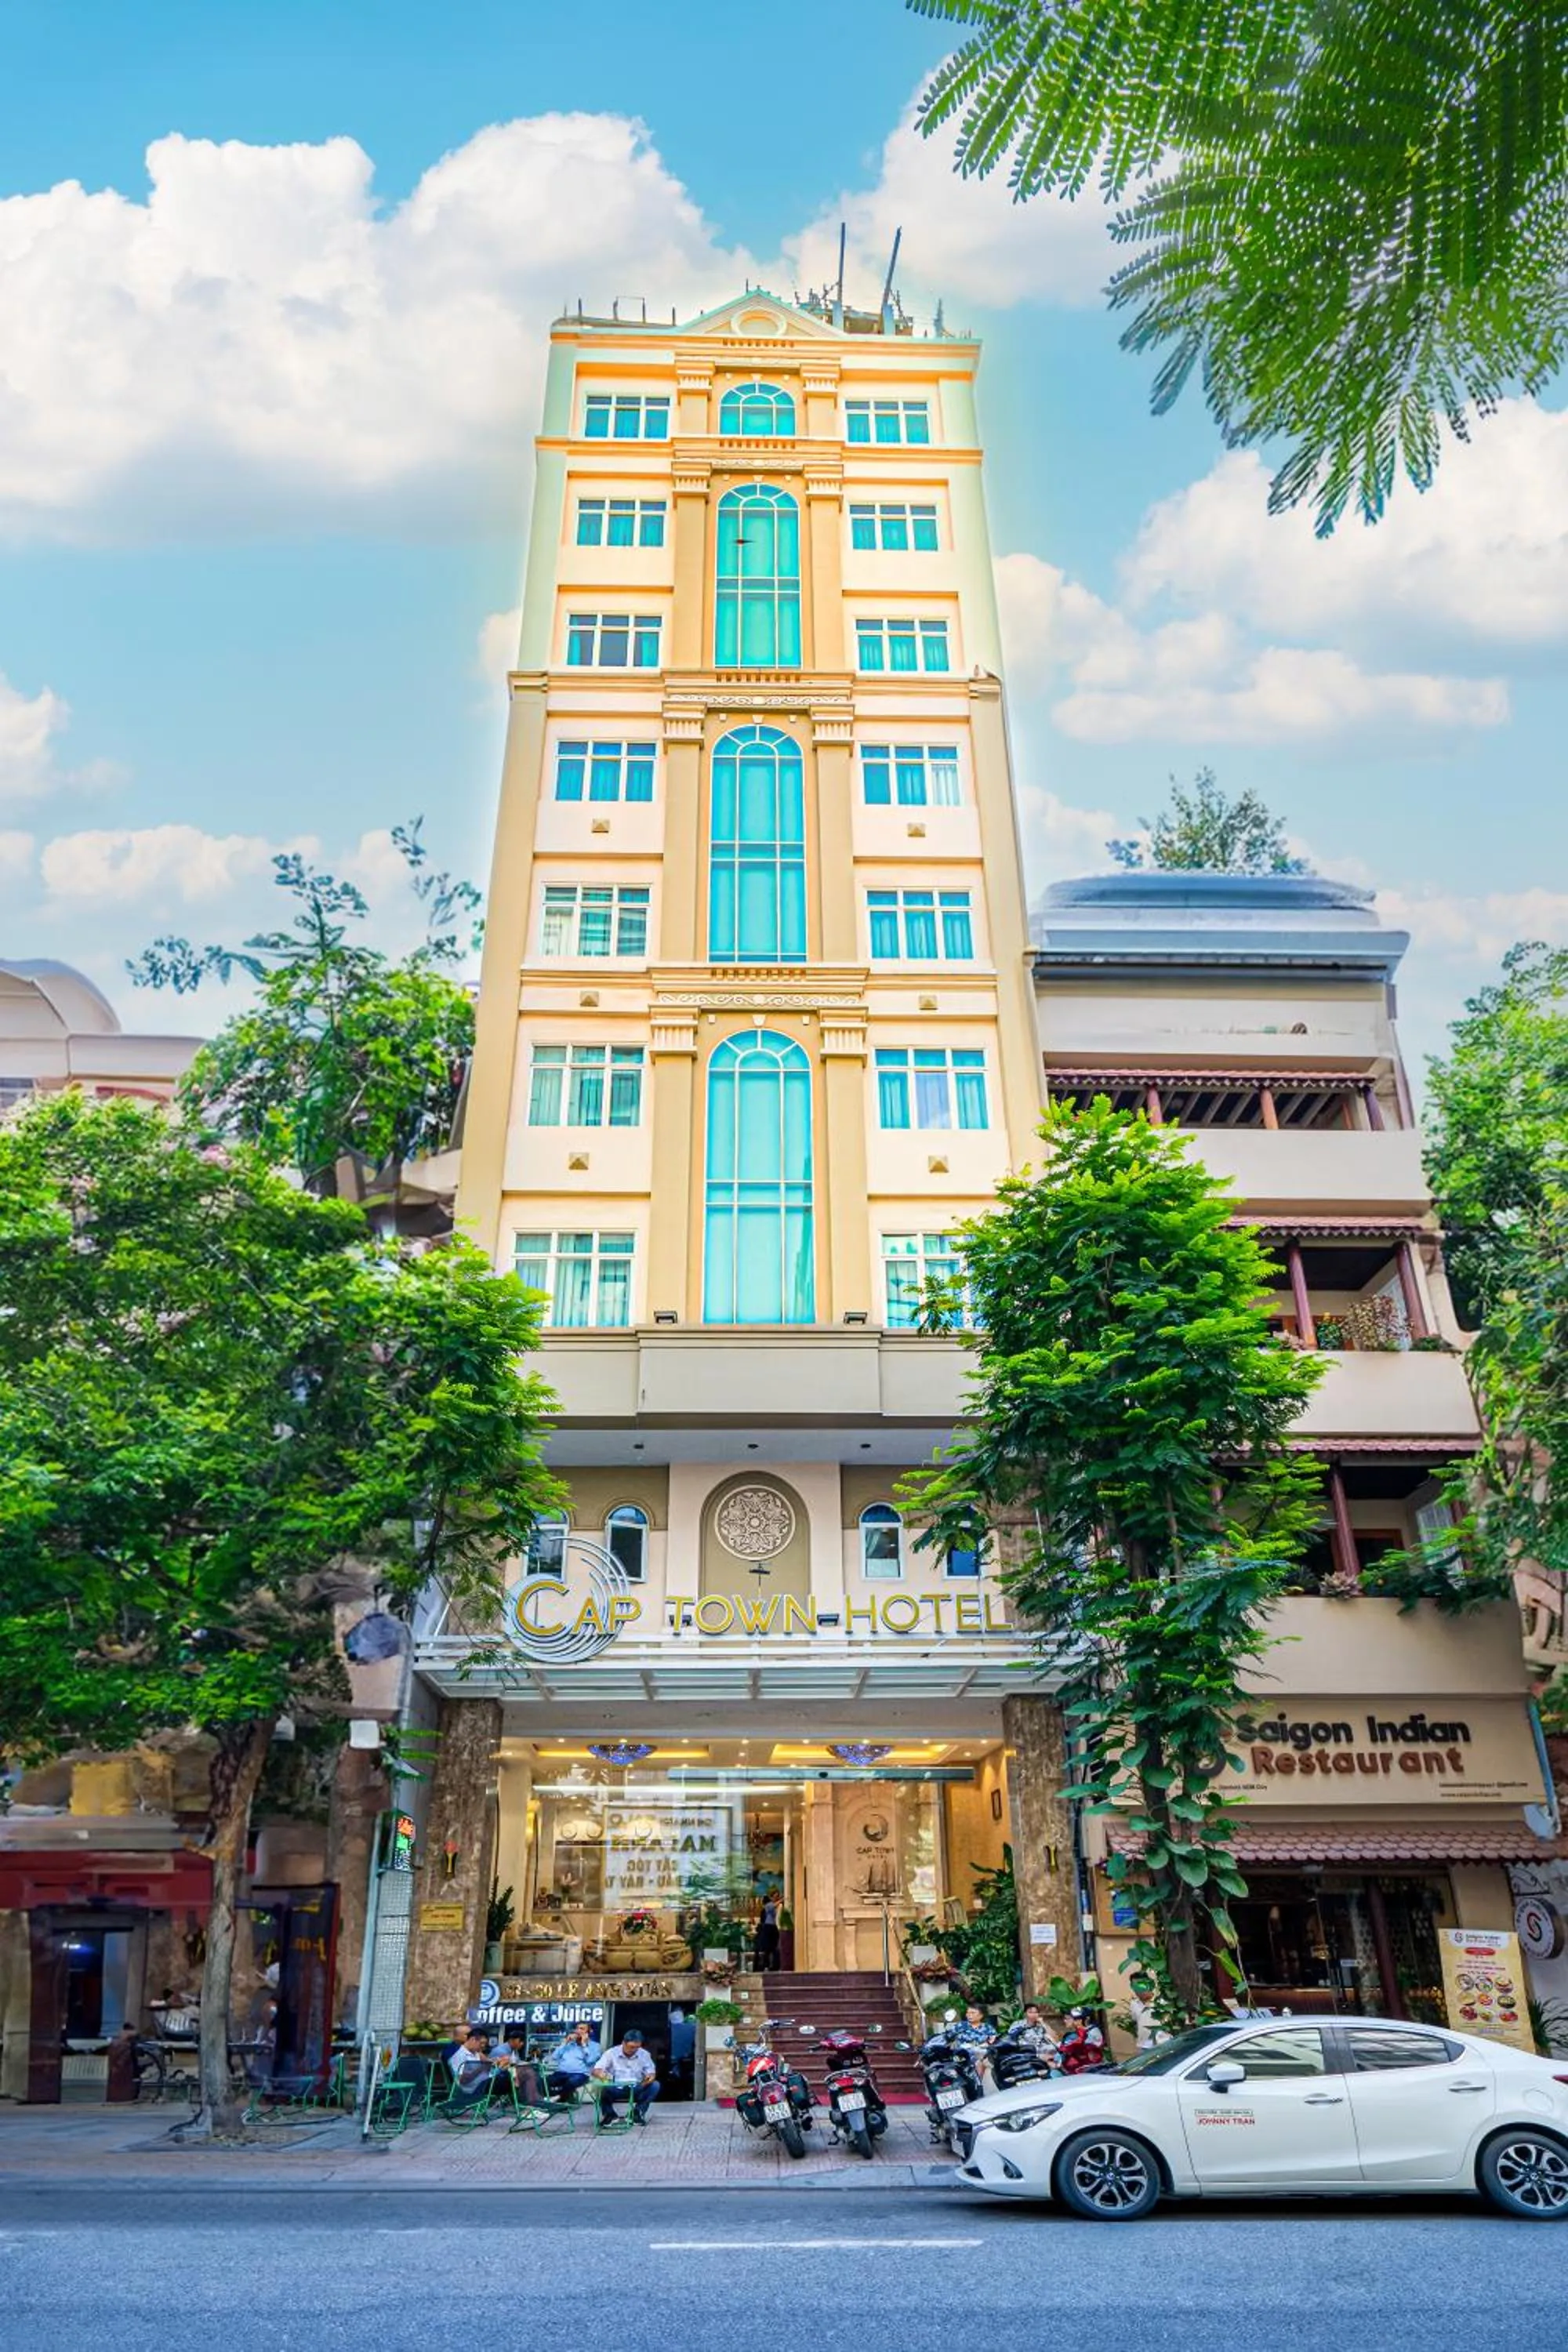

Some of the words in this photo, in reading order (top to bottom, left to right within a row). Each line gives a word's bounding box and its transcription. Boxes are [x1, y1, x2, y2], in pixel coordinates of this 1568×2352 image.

[516, 1580, 642, 1637] CAP
[666, 1593, 818, 1635] TOWN
[843, 1592, 1014, 1634] HOTEL
[1236, 1712, 1354, 1751] Saigon
[1367, 1713, 1471, 1744] Indian
[1250, 1745, 1465, 1775] Restaurant
[532, 2005, 546, 2023] &
[551, 2005, 603, 2023] Juice
